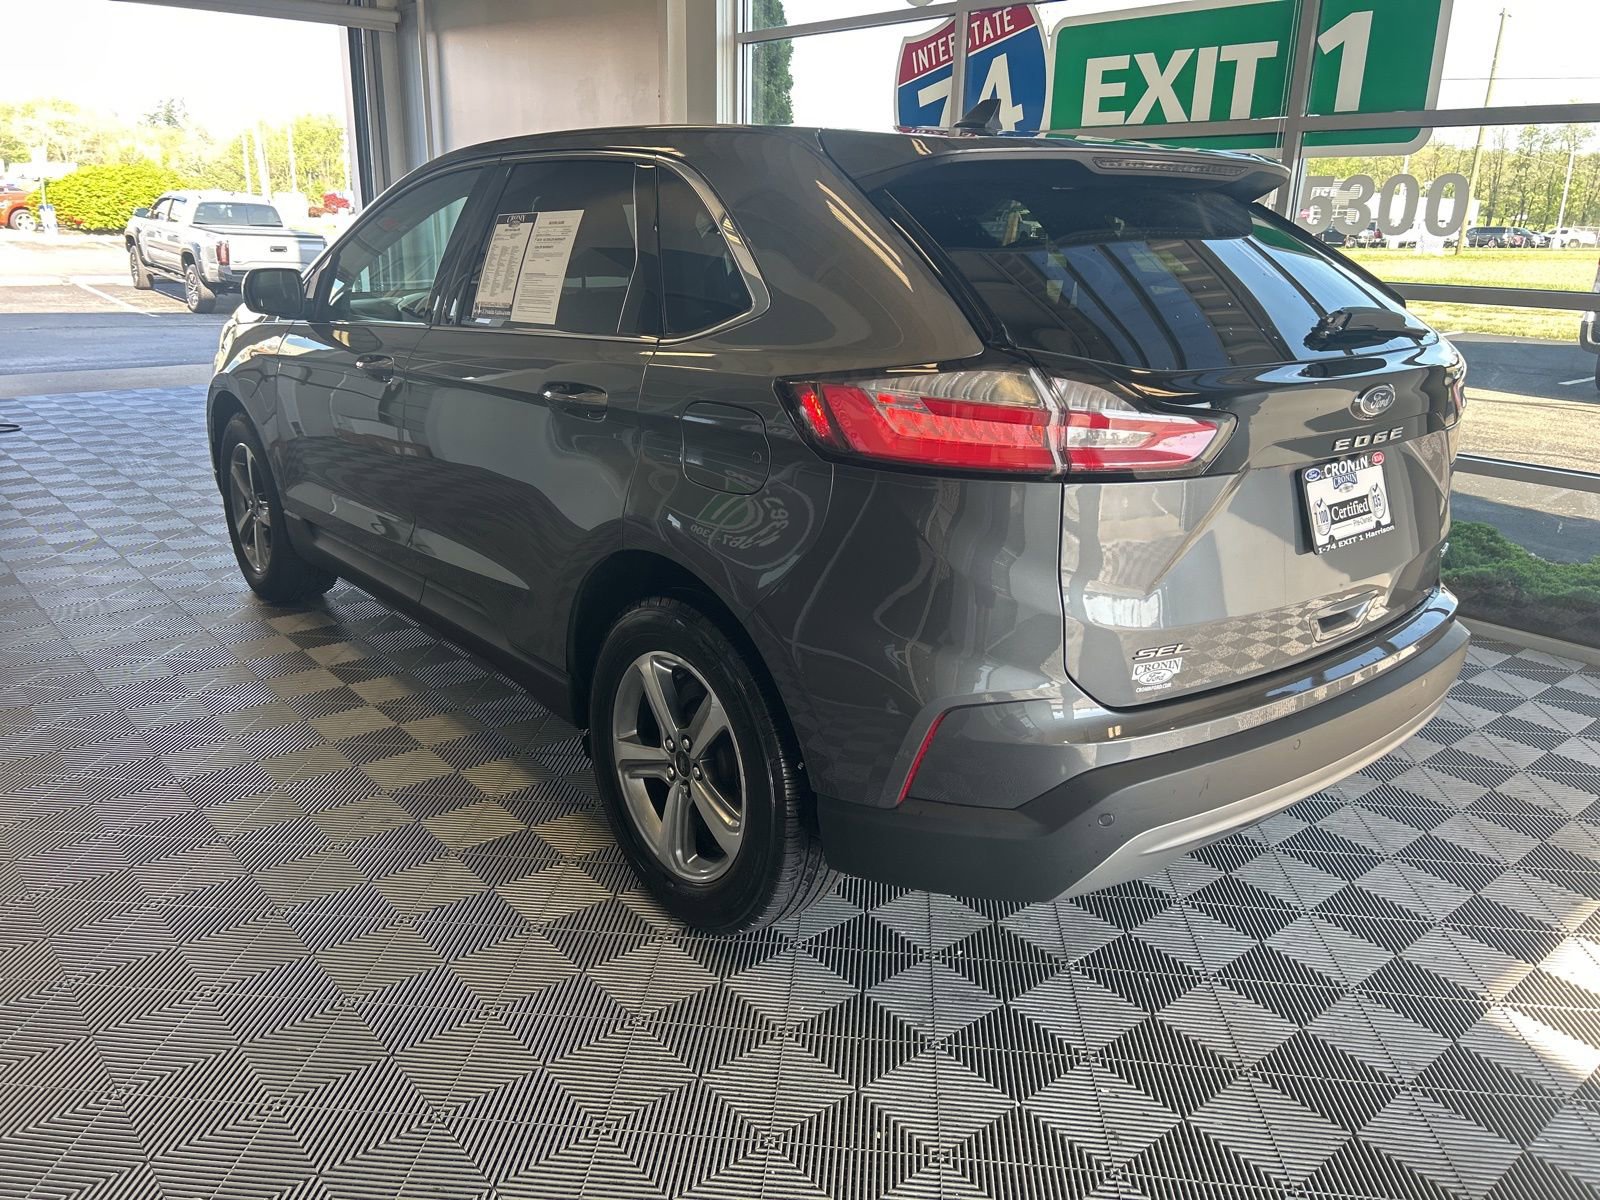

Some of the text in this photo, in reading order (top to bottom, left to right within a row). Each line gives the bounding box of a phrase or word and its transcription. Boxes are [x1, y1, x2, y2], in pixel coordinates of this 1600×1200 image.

[912, 7, 1015, 74] INTETATE
[1080, 10, 1373, 127] EXIT 1
[1297, 173, 1470, 237] 5300
[1370, 392, 1391, 410] Ford
[1334, 427, 1403, 451] EDGE
[1324, 455, 1369, 477] CRONIN
[1333, 473, 1357, 489] CRONIN
[1331, 498, 1369, 520] Certified
[1318, 542, 1337, 554] I-74
[1338, 536, 1357, 548] EXIT
[1365, 524, 1395, 539] Harrison
[1132, 643, 1191, 660] SEL
[1134, 658, 1181, 676] CRONIN
[1146, 672, 1166, 683] Ford
